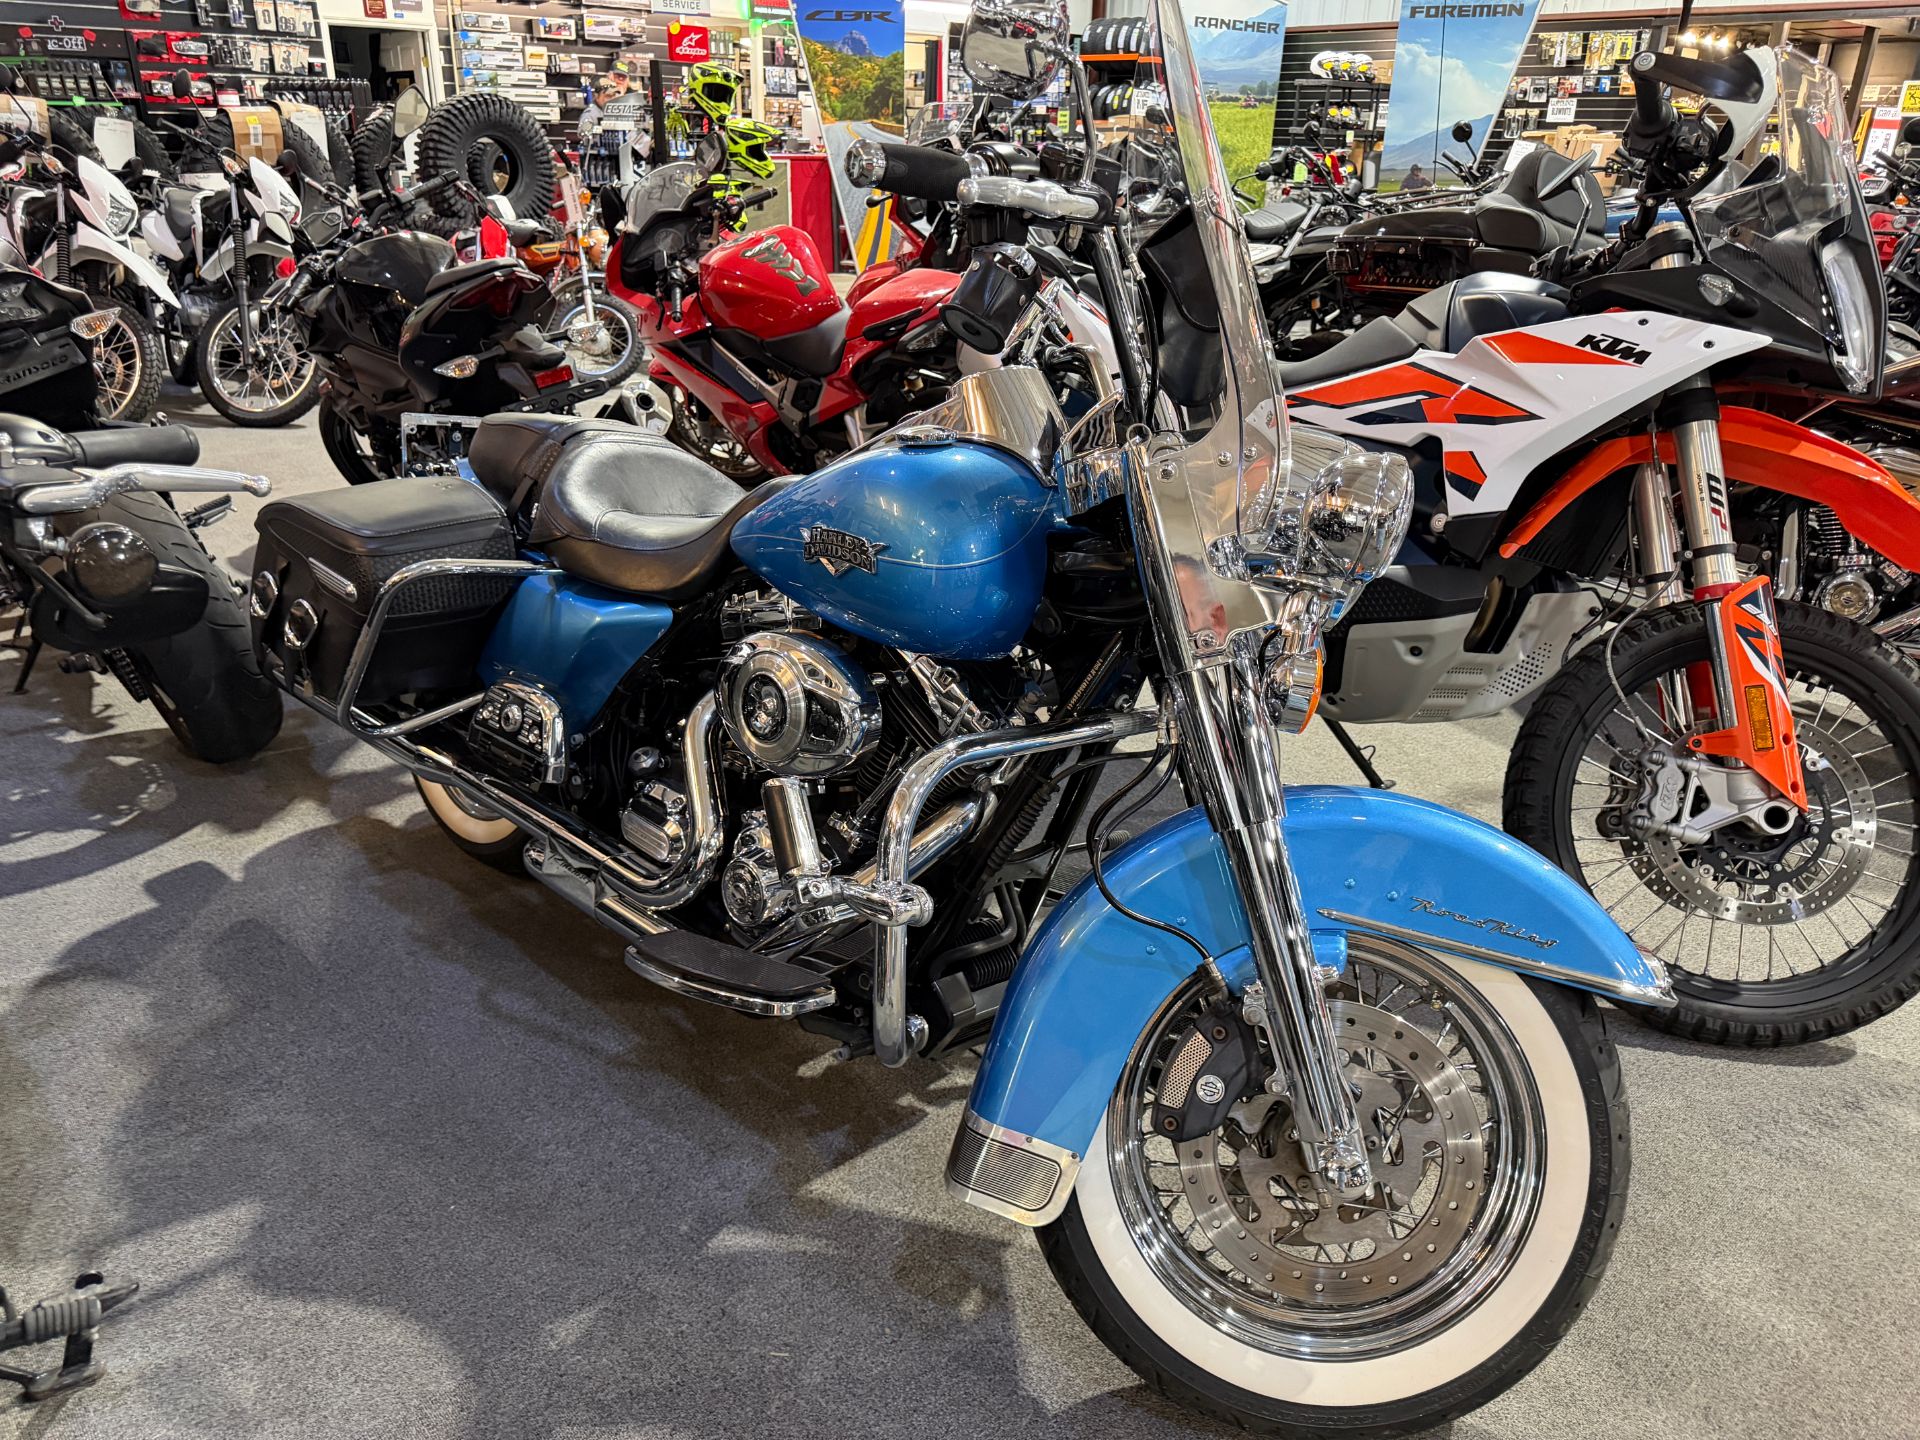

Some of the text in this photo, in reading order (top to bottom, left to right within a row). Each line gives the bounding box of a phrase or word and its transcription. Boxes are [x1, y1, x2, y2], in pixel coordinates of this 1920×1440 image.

[663, 0, 701, 10] SERVICE
[1409, 3, 1525, 19] FOREMAN
[804, 9, 899, 24] CBR
[1194, 16, 1280, 35] RANCHER
[605, 104, 632, 114] ECSTA
[1575, 333, 1652, 365] KTM
[804, 543, 872, 571] DAVIDSON
